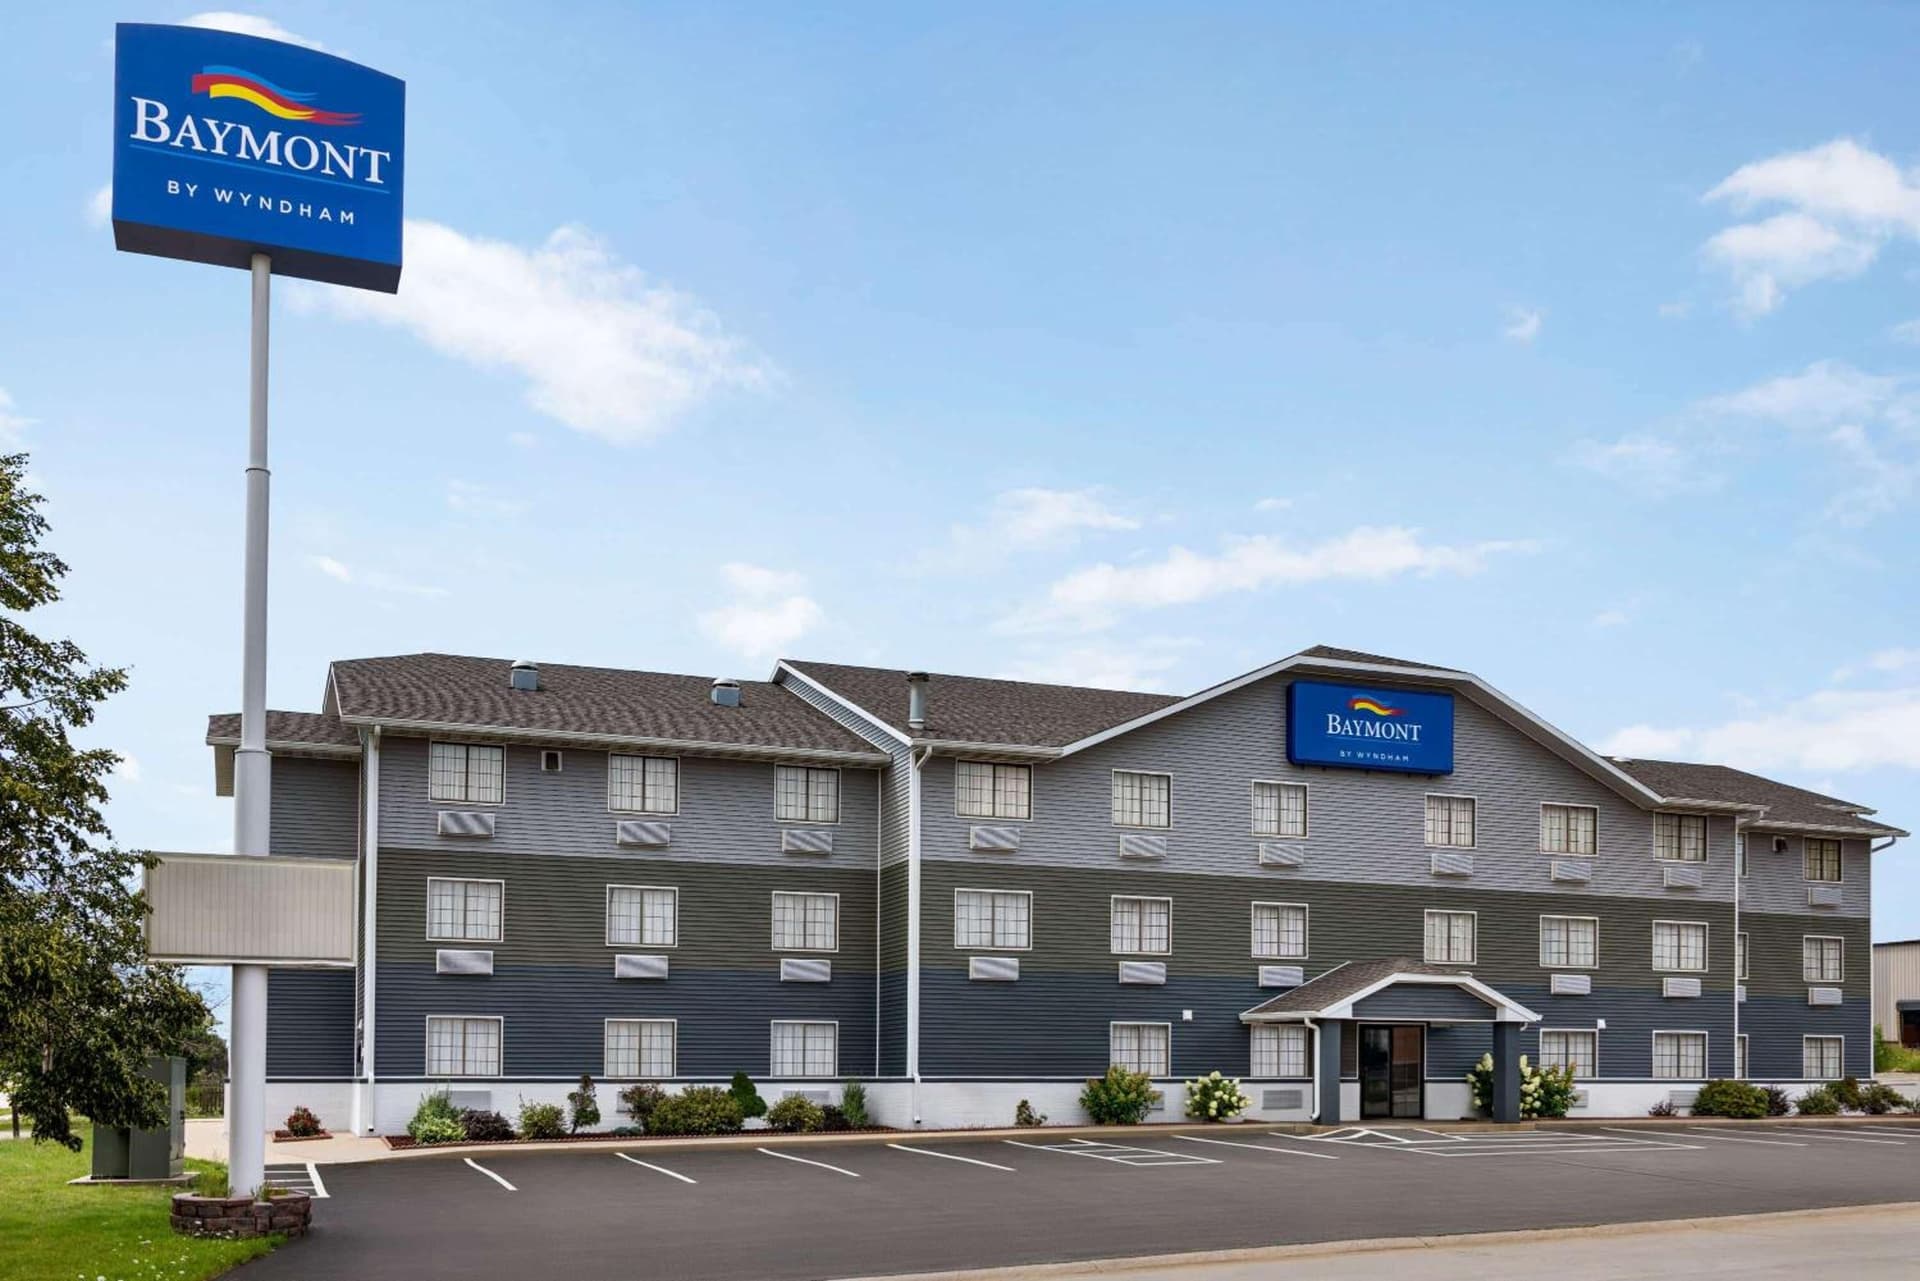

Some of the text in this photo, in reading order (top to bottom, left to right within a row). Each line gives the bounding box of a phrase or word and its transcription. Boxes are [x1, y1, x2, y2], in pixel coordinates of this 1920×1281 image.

[130, 96, 391, 184] BAYMONT
[167, 180, 355, 225] BY WYNDHAM
[1326, 713, 1422, 741] BAYMONT
[1339, 750, 1409, 762] BY WYNDHAM
